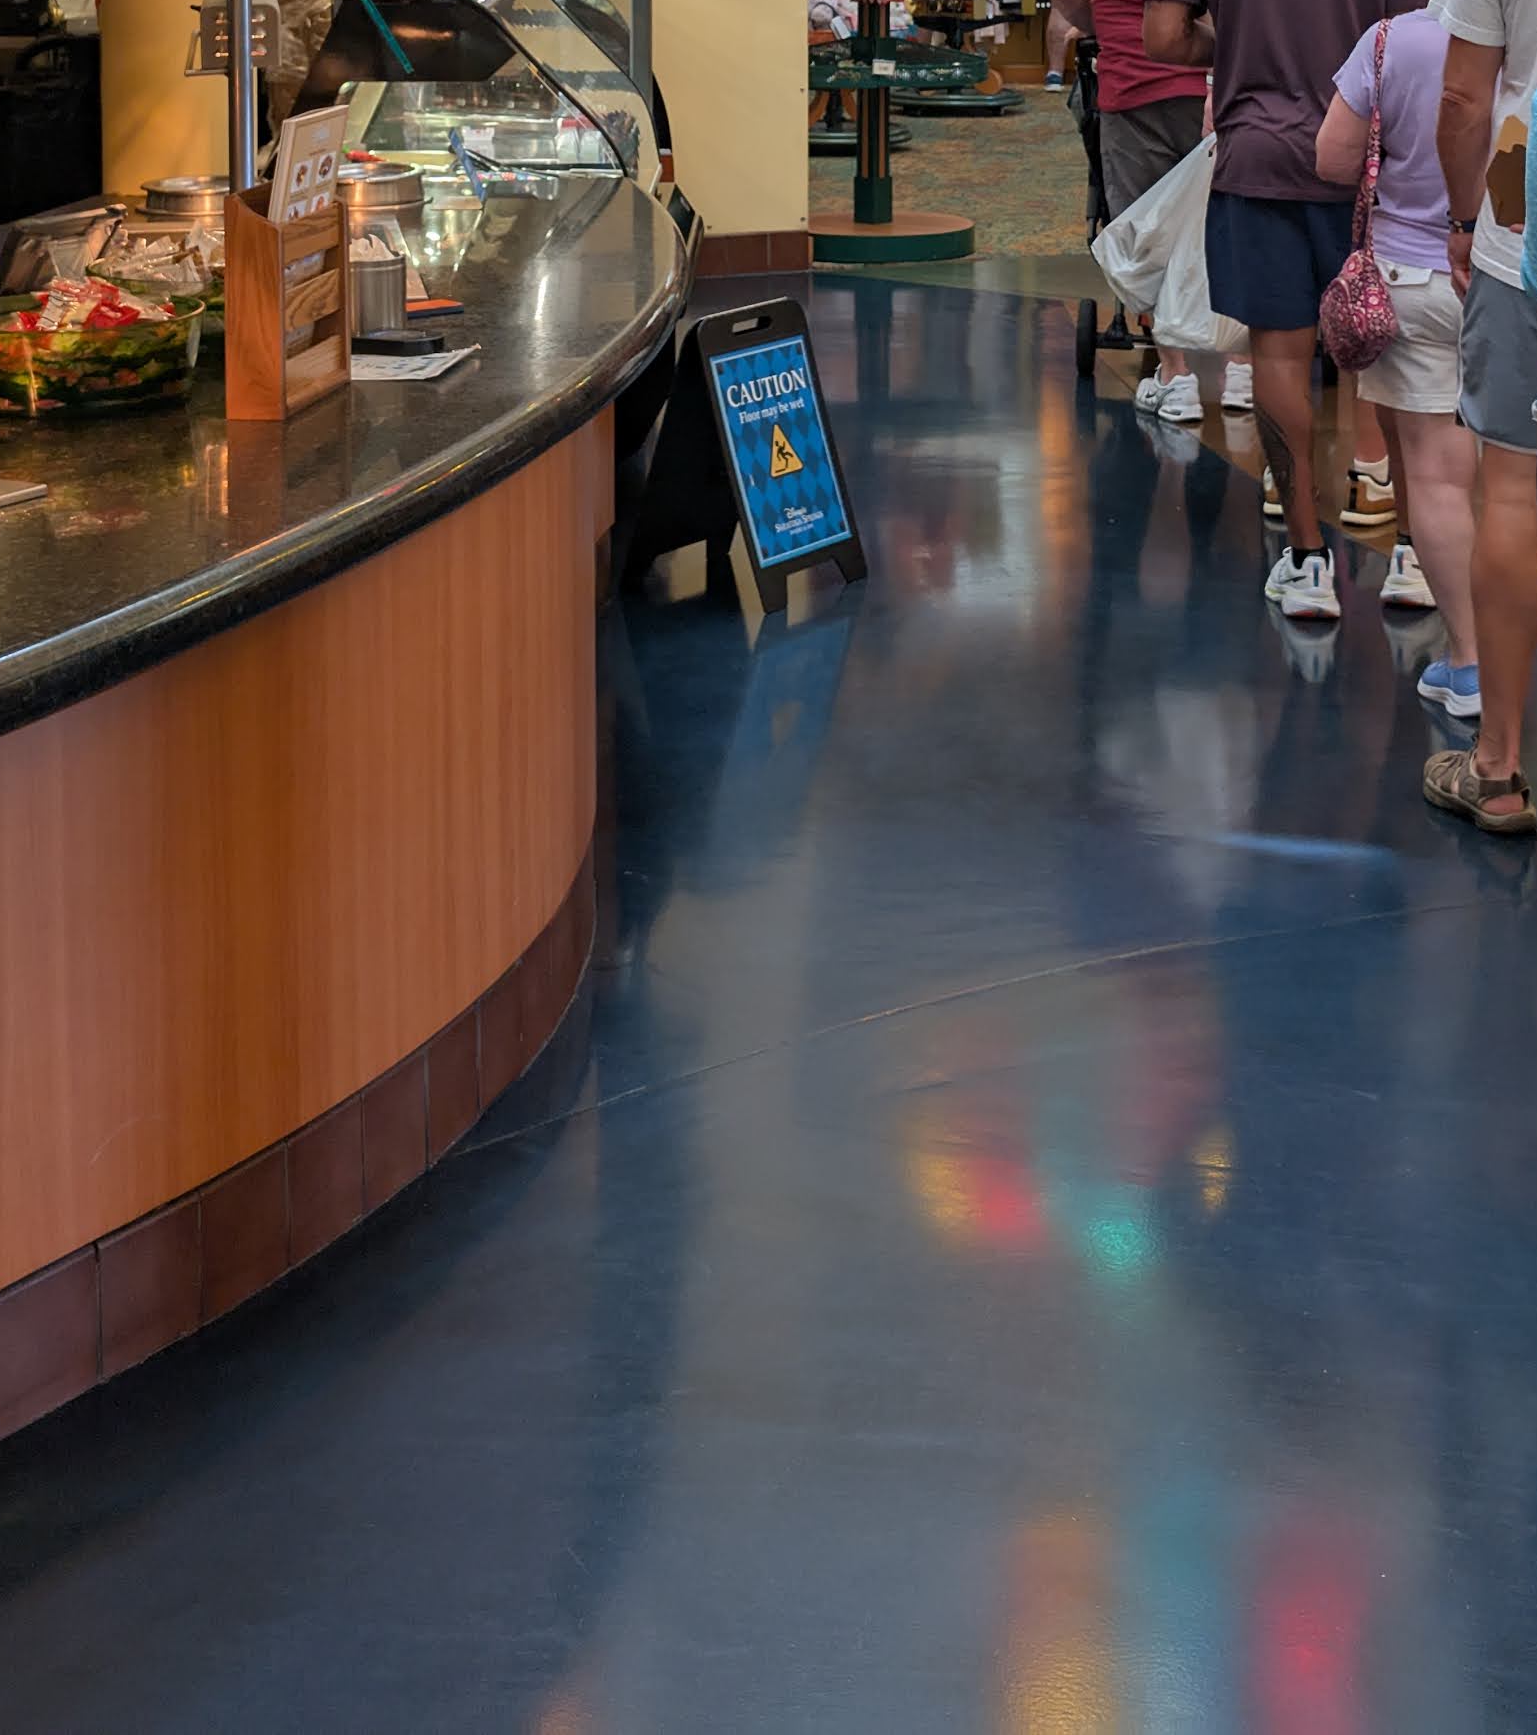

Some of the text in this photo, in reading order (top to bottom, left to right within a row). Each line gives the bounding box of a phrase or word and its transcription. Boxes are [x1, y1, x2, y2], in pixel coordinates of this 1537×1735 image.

[726, 368, 807, 408] CAUTION
[739, 396, 805, 425] Floor may be wet
